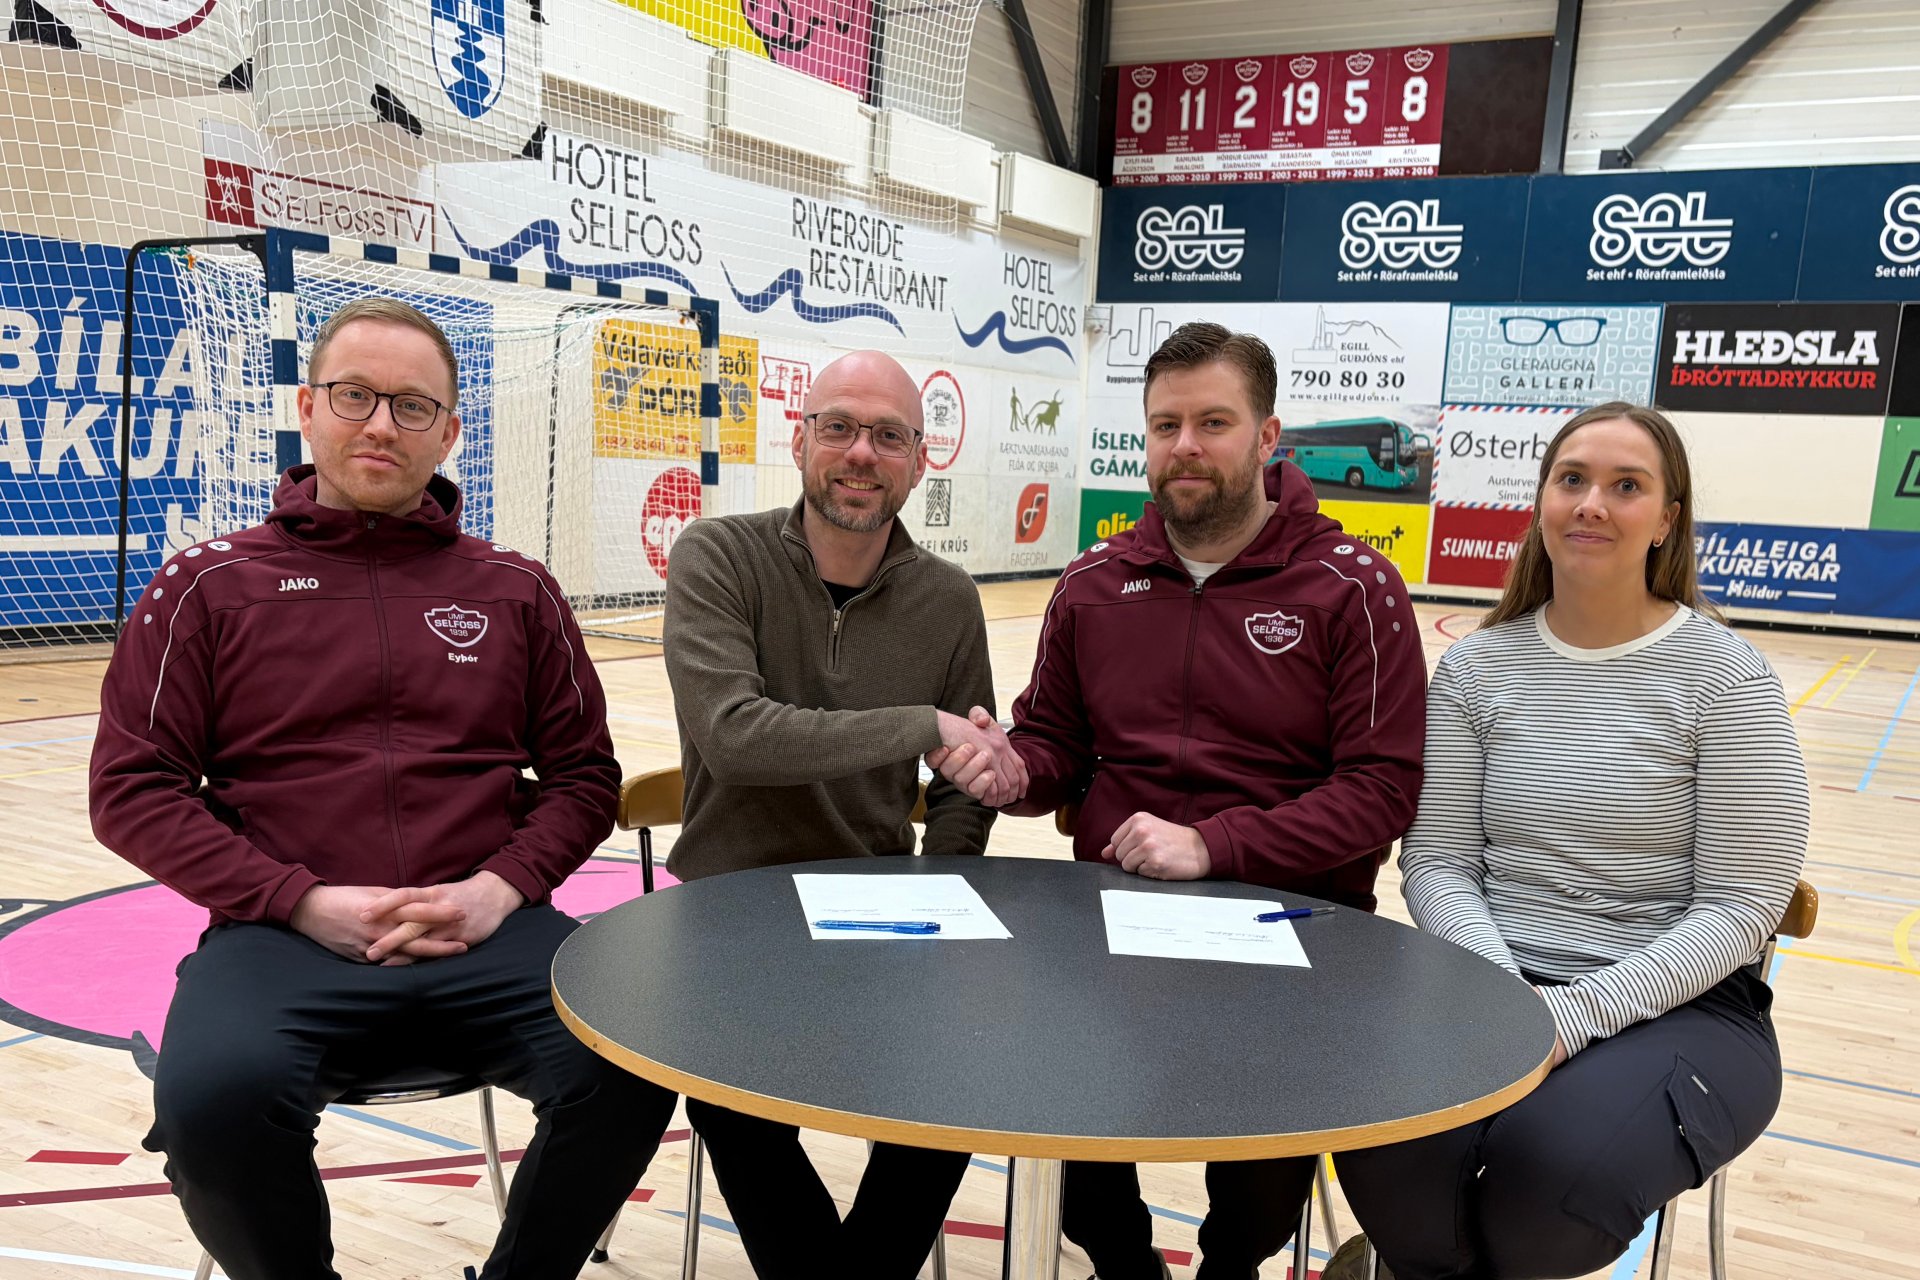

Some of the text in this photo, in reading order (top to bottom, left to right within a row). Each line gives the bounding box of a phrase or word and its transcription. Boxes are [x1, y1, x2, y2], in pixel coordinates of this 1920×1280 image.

[1179, 88, 1206, 131] 11
[1233, 85, 1258, 128] 2
[1282, 81, 1320, 126] 19
[1344, 79, 1370, 124] 5
[1402, 76, 1428, 121] 8
[1131, 91, 1153, 133] 8
[552, 134, 656, 204] HOTEL
[1411, 166, 1434, 176] 2016
[568, 197, 702, 265] SELFOSS
[793, 197, 904, 261] RIVERSIDE
[809, 248, 948, 312] RESTAURANT
[1003, 252, 1055, 295] HOTEL
[1133, 271, 1148, 281] Set
[1149, 271, 1165, 282] ehf
[1337, 270, 1353, 281] Set
[1354, 270, 1373, 281] ehf
[1586, 267, 1726, 281] Set ehf Röraframleiðsla
[1875, 265, 1897, 278] Set
[1010, 294, 1076, 337] SELFOSS
[1341, 342, 1370, 351] EGILL
[1672, 330, 1880, 366] HLEÐSLA
[1501, 357, 1596, 372] GLERAUGNA
[1670, 364, 1877, 388] ÍÞRÓTTADRYKKUR
[1291, 370, 1405, 388] 790 80 30
[1500, 373, 1594, 390] GALLERÍ
[1092, 428, 1146, 451] ÍSLEN
[1450, 430, 1549, 461] Østerb
[1090, 454, 1148, 477] GÁMA
[1522, 492, 1535, 501] 48
[940, 536, 968, 552] KRÚS
[1440, 537, 1520, 560] SUNNLEN
[1010, 551, 1048, 566] FAGFORM
[1699, 555, 1841, 582] KUREYRAR
[278, 577, 319, 592] JAKO
[1121, 578, 1151, 594] JAKO
[434, 618, 481, 630] SELFOSS
[1252, 625, 1298, 637] SELFOSS
[1267, 618, 1287, 627] UMF
[448, 652, 478, 664] Eyþór
